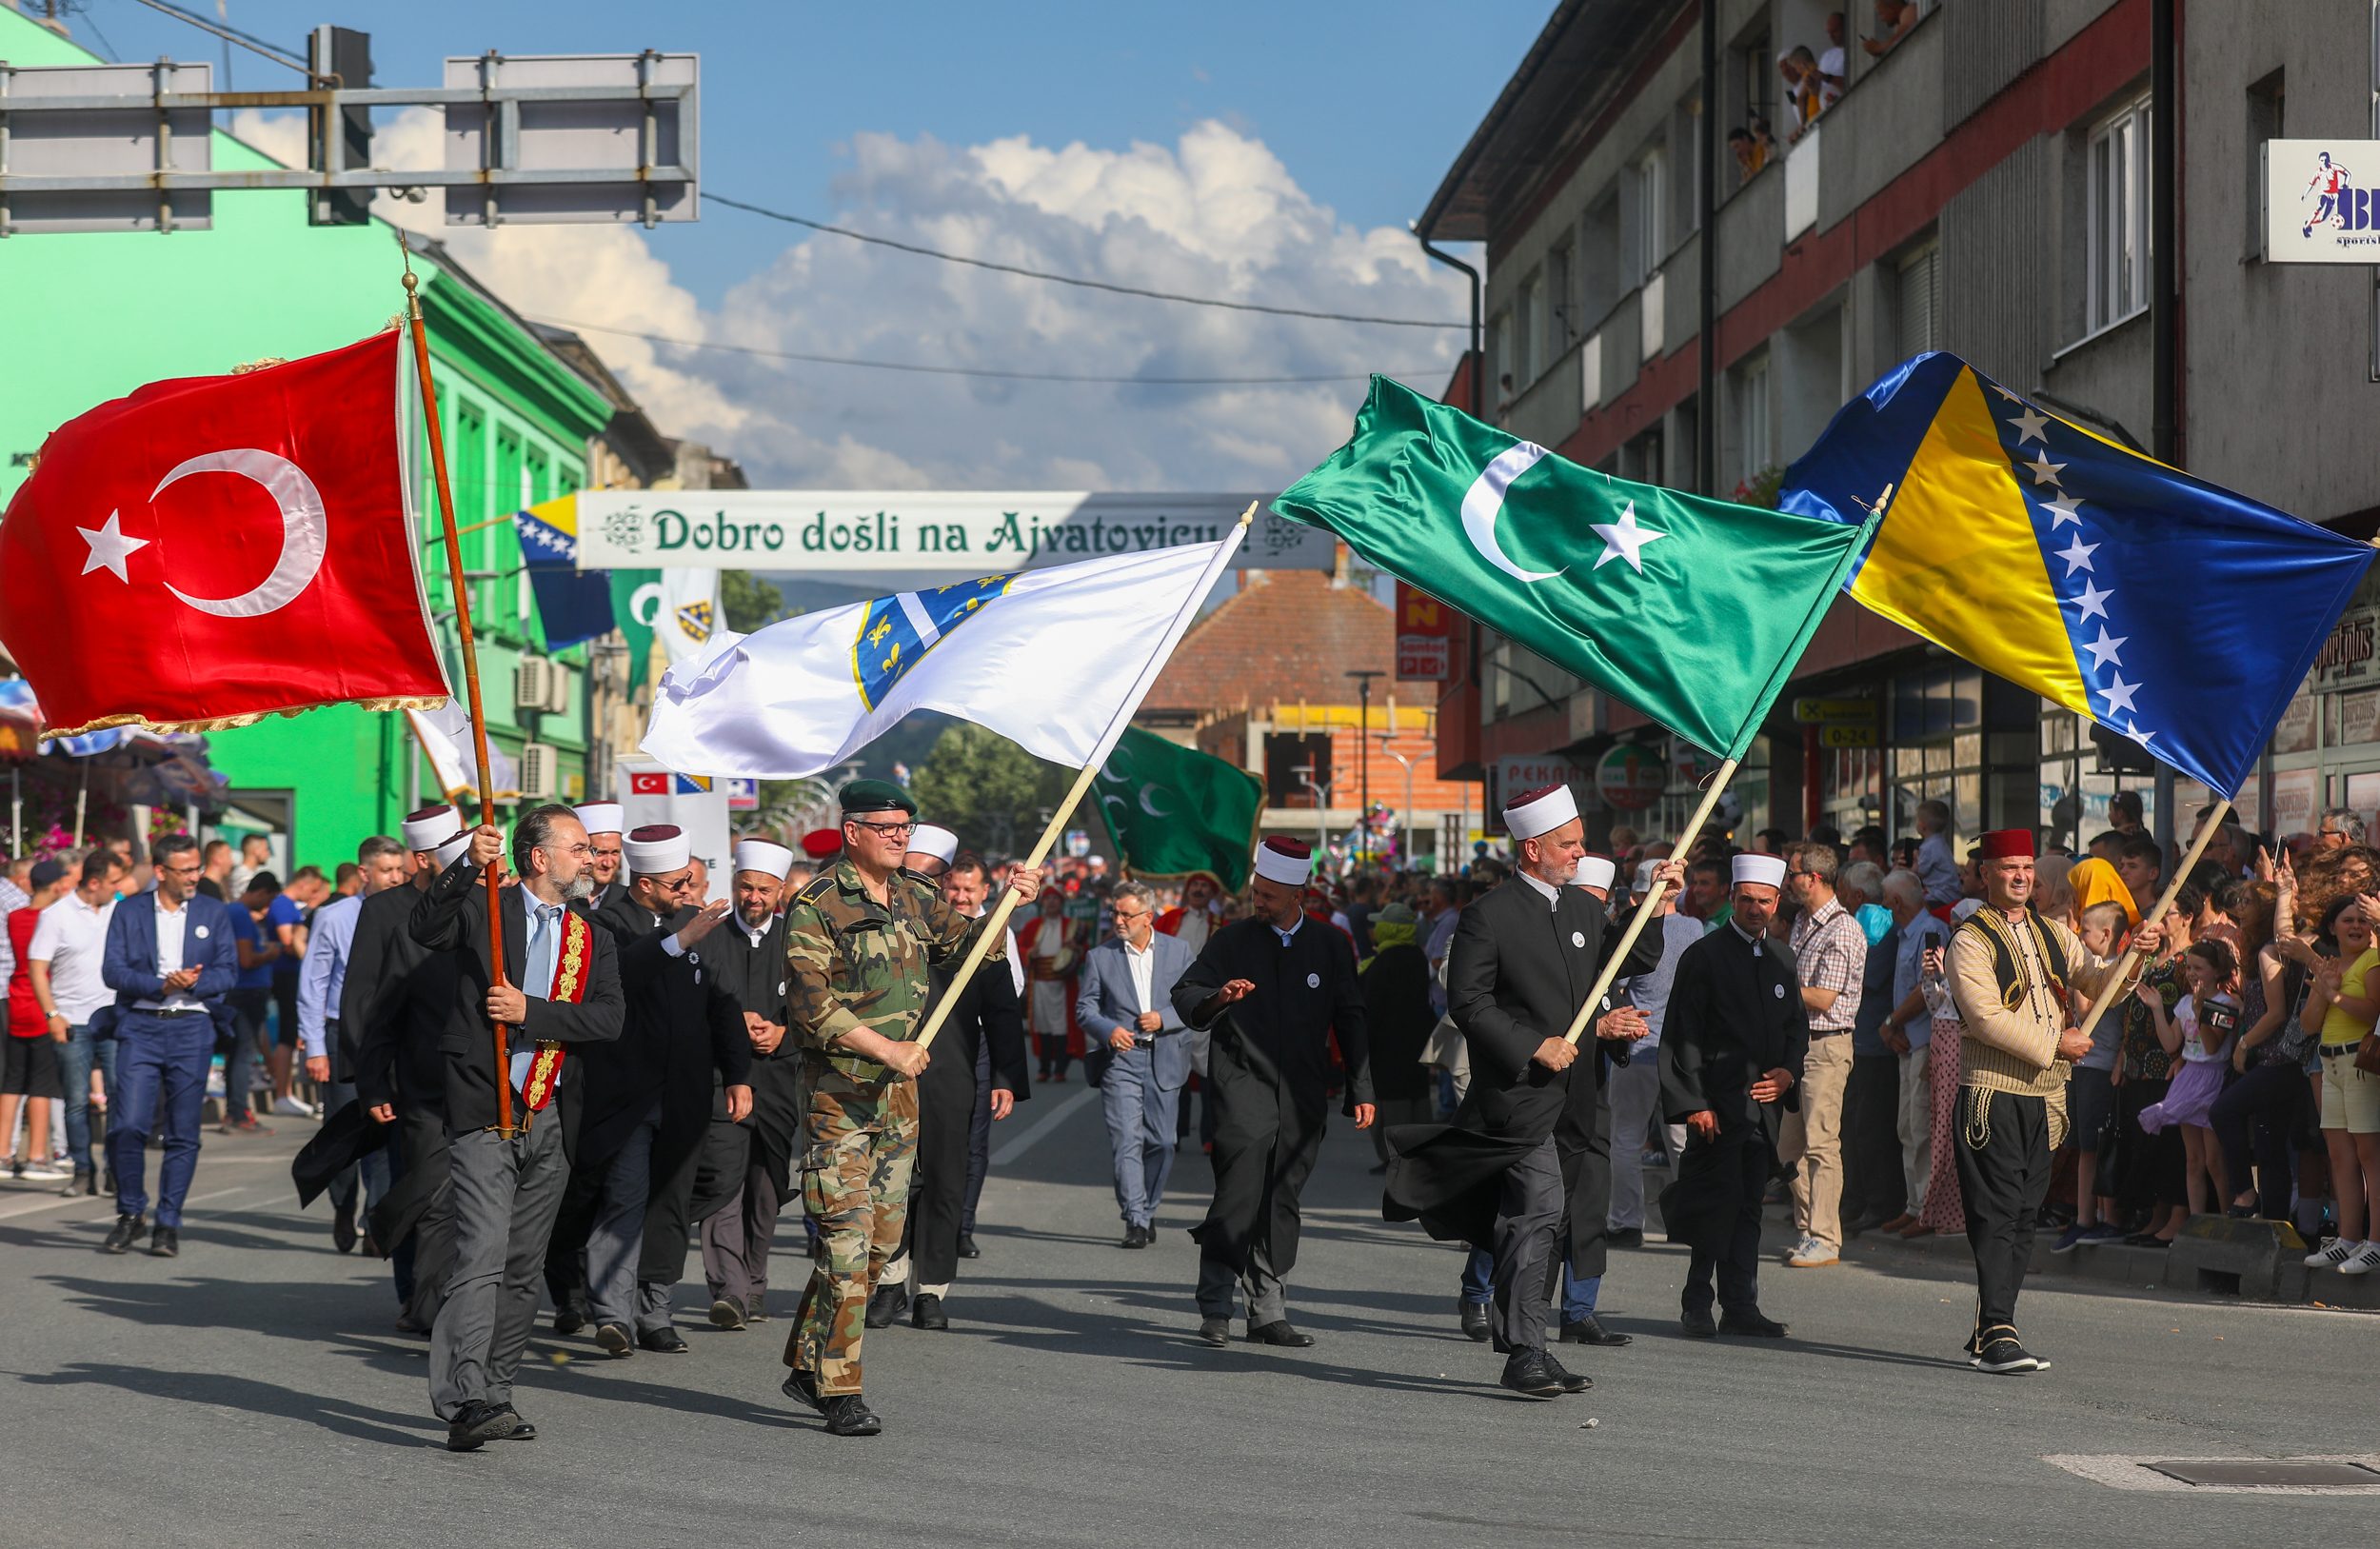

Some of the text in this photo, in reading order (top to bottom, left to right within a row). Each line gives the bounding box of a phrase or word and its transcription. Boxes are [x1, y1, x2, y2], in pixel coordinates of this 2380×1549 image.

[651, 509, 784, 551] Dobro
[802, 511, 901, 552] došli
[918, 523, 969, 552] na
[2313, 621, 2372, 682] portplus
[1832, 729, 1868, 744] 0-24
